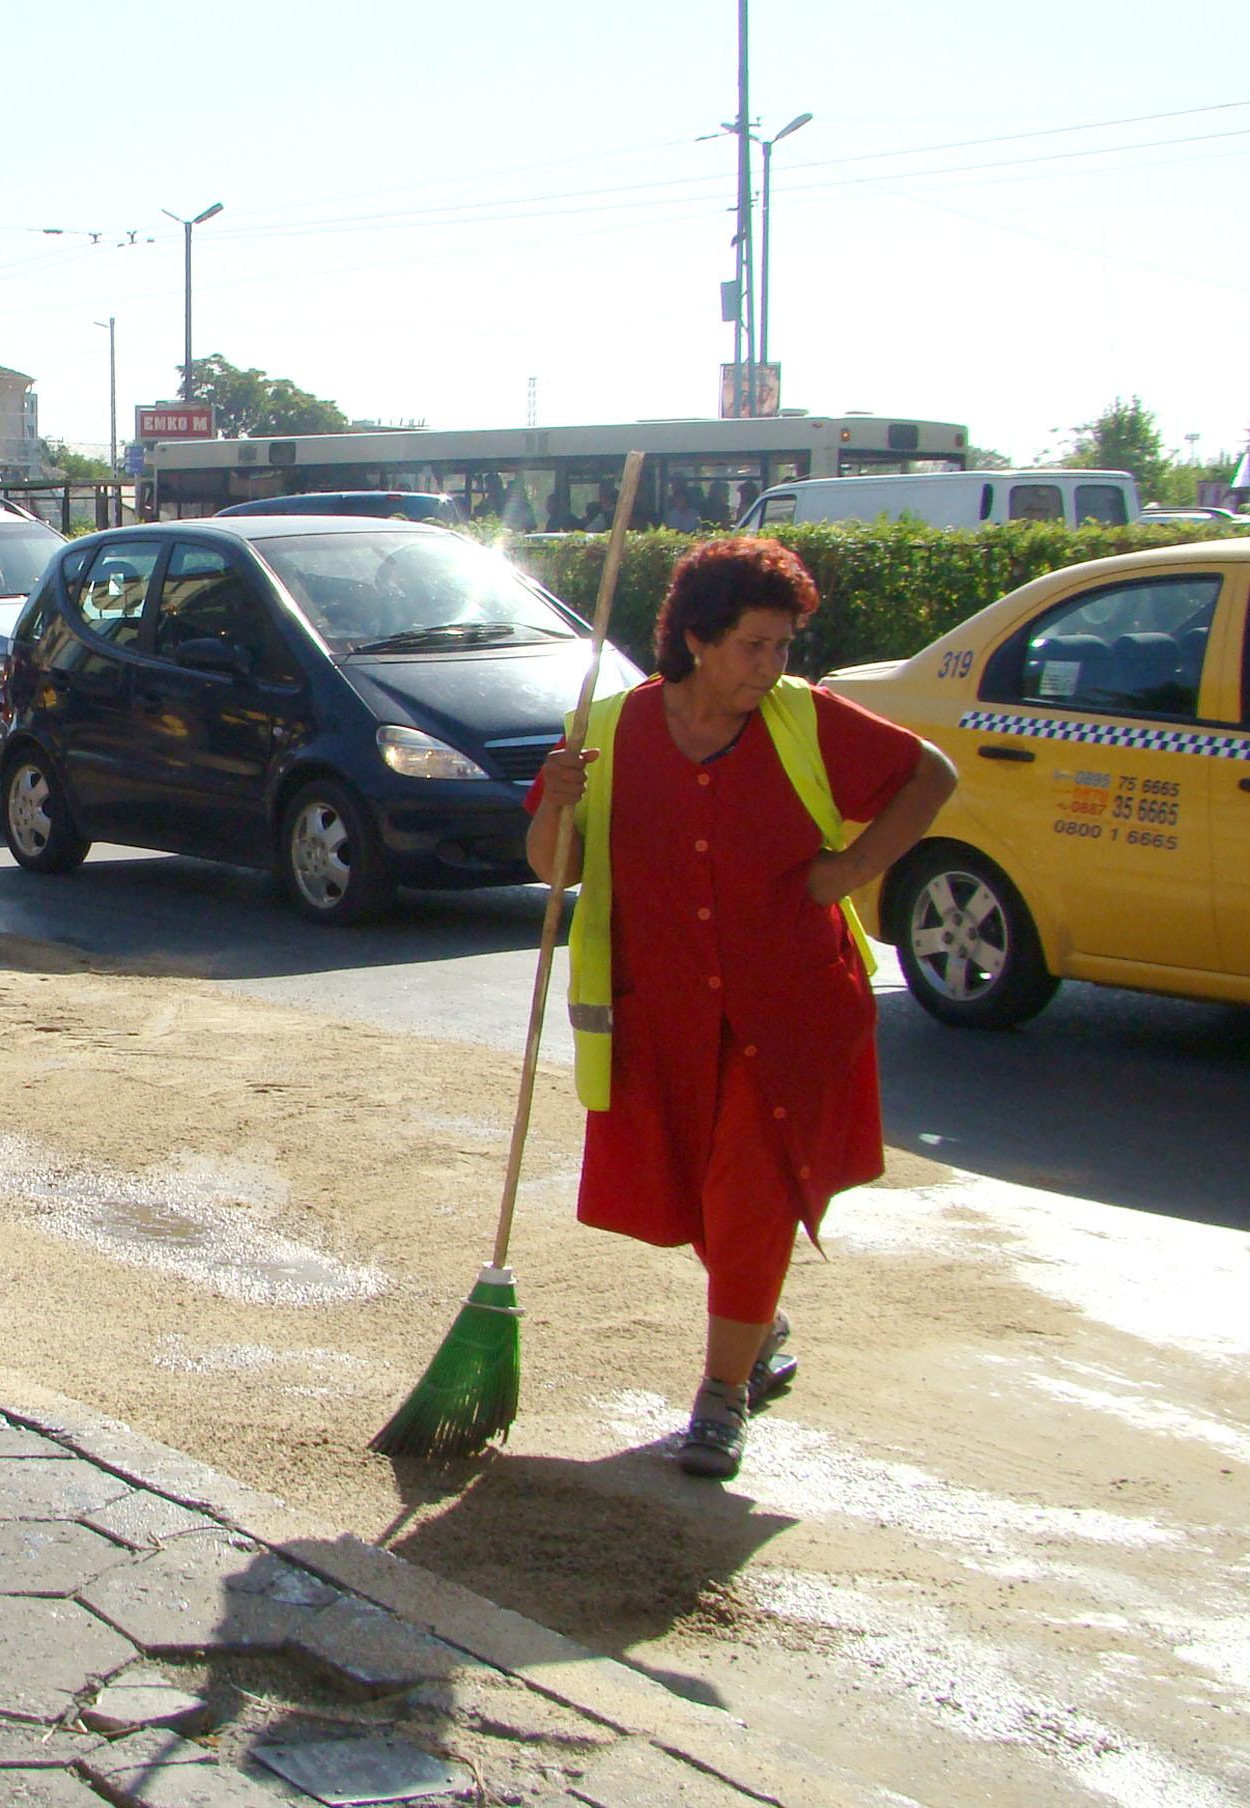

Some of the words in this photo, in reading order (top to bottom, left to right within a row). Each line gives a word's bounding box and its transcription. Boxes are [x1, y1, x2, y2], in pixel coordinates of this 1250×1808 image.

[937, 650, 974, 678] 319
[1119, 776, 1138, 791] 75
[1142, 779, 1180, 797] 6665
[1113, 795, 1134, 819] 35
[1138, 799, 1179, 826] 6665
[1054, 820, 1102, 838] 0800
[1111, 828, 1118, 841] 1
[1127, 831, 1178, 850] 6665
